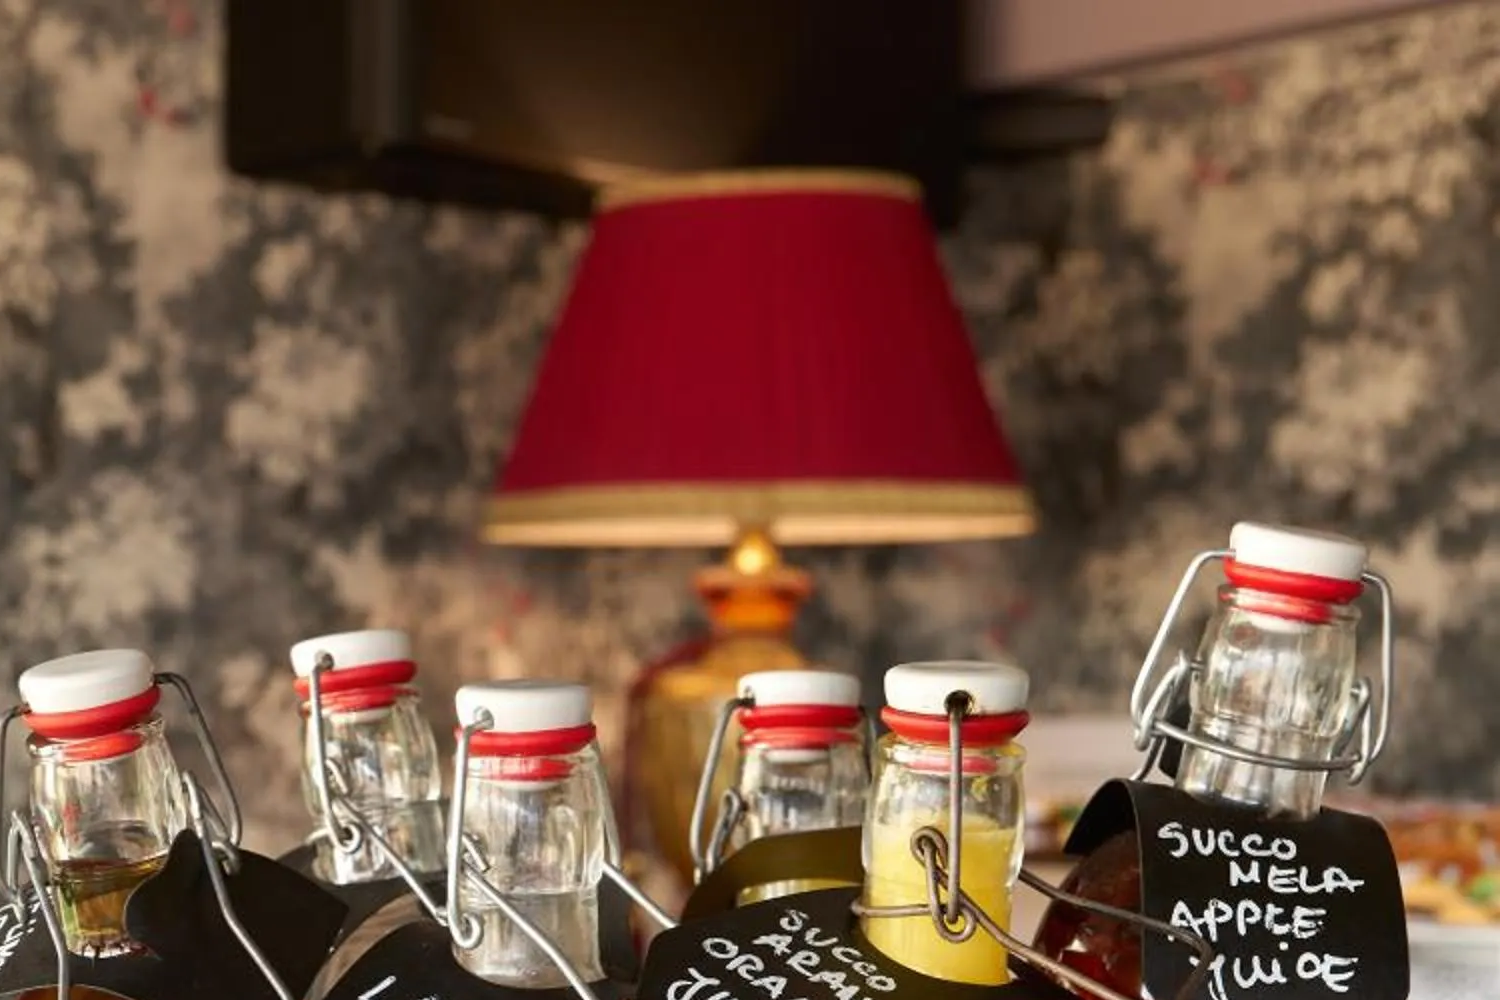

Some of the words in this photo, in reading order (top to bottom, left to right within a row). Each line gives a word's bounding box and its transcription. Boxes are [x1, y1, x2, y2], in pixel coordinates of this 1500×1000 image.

[1156, 820, 1298, 860] SUCCO
[1229, 860, 1365, 894] MELA
[1169, 898, 1327, 942] APPLE
[779, 907, 897, 993] SUCCO
